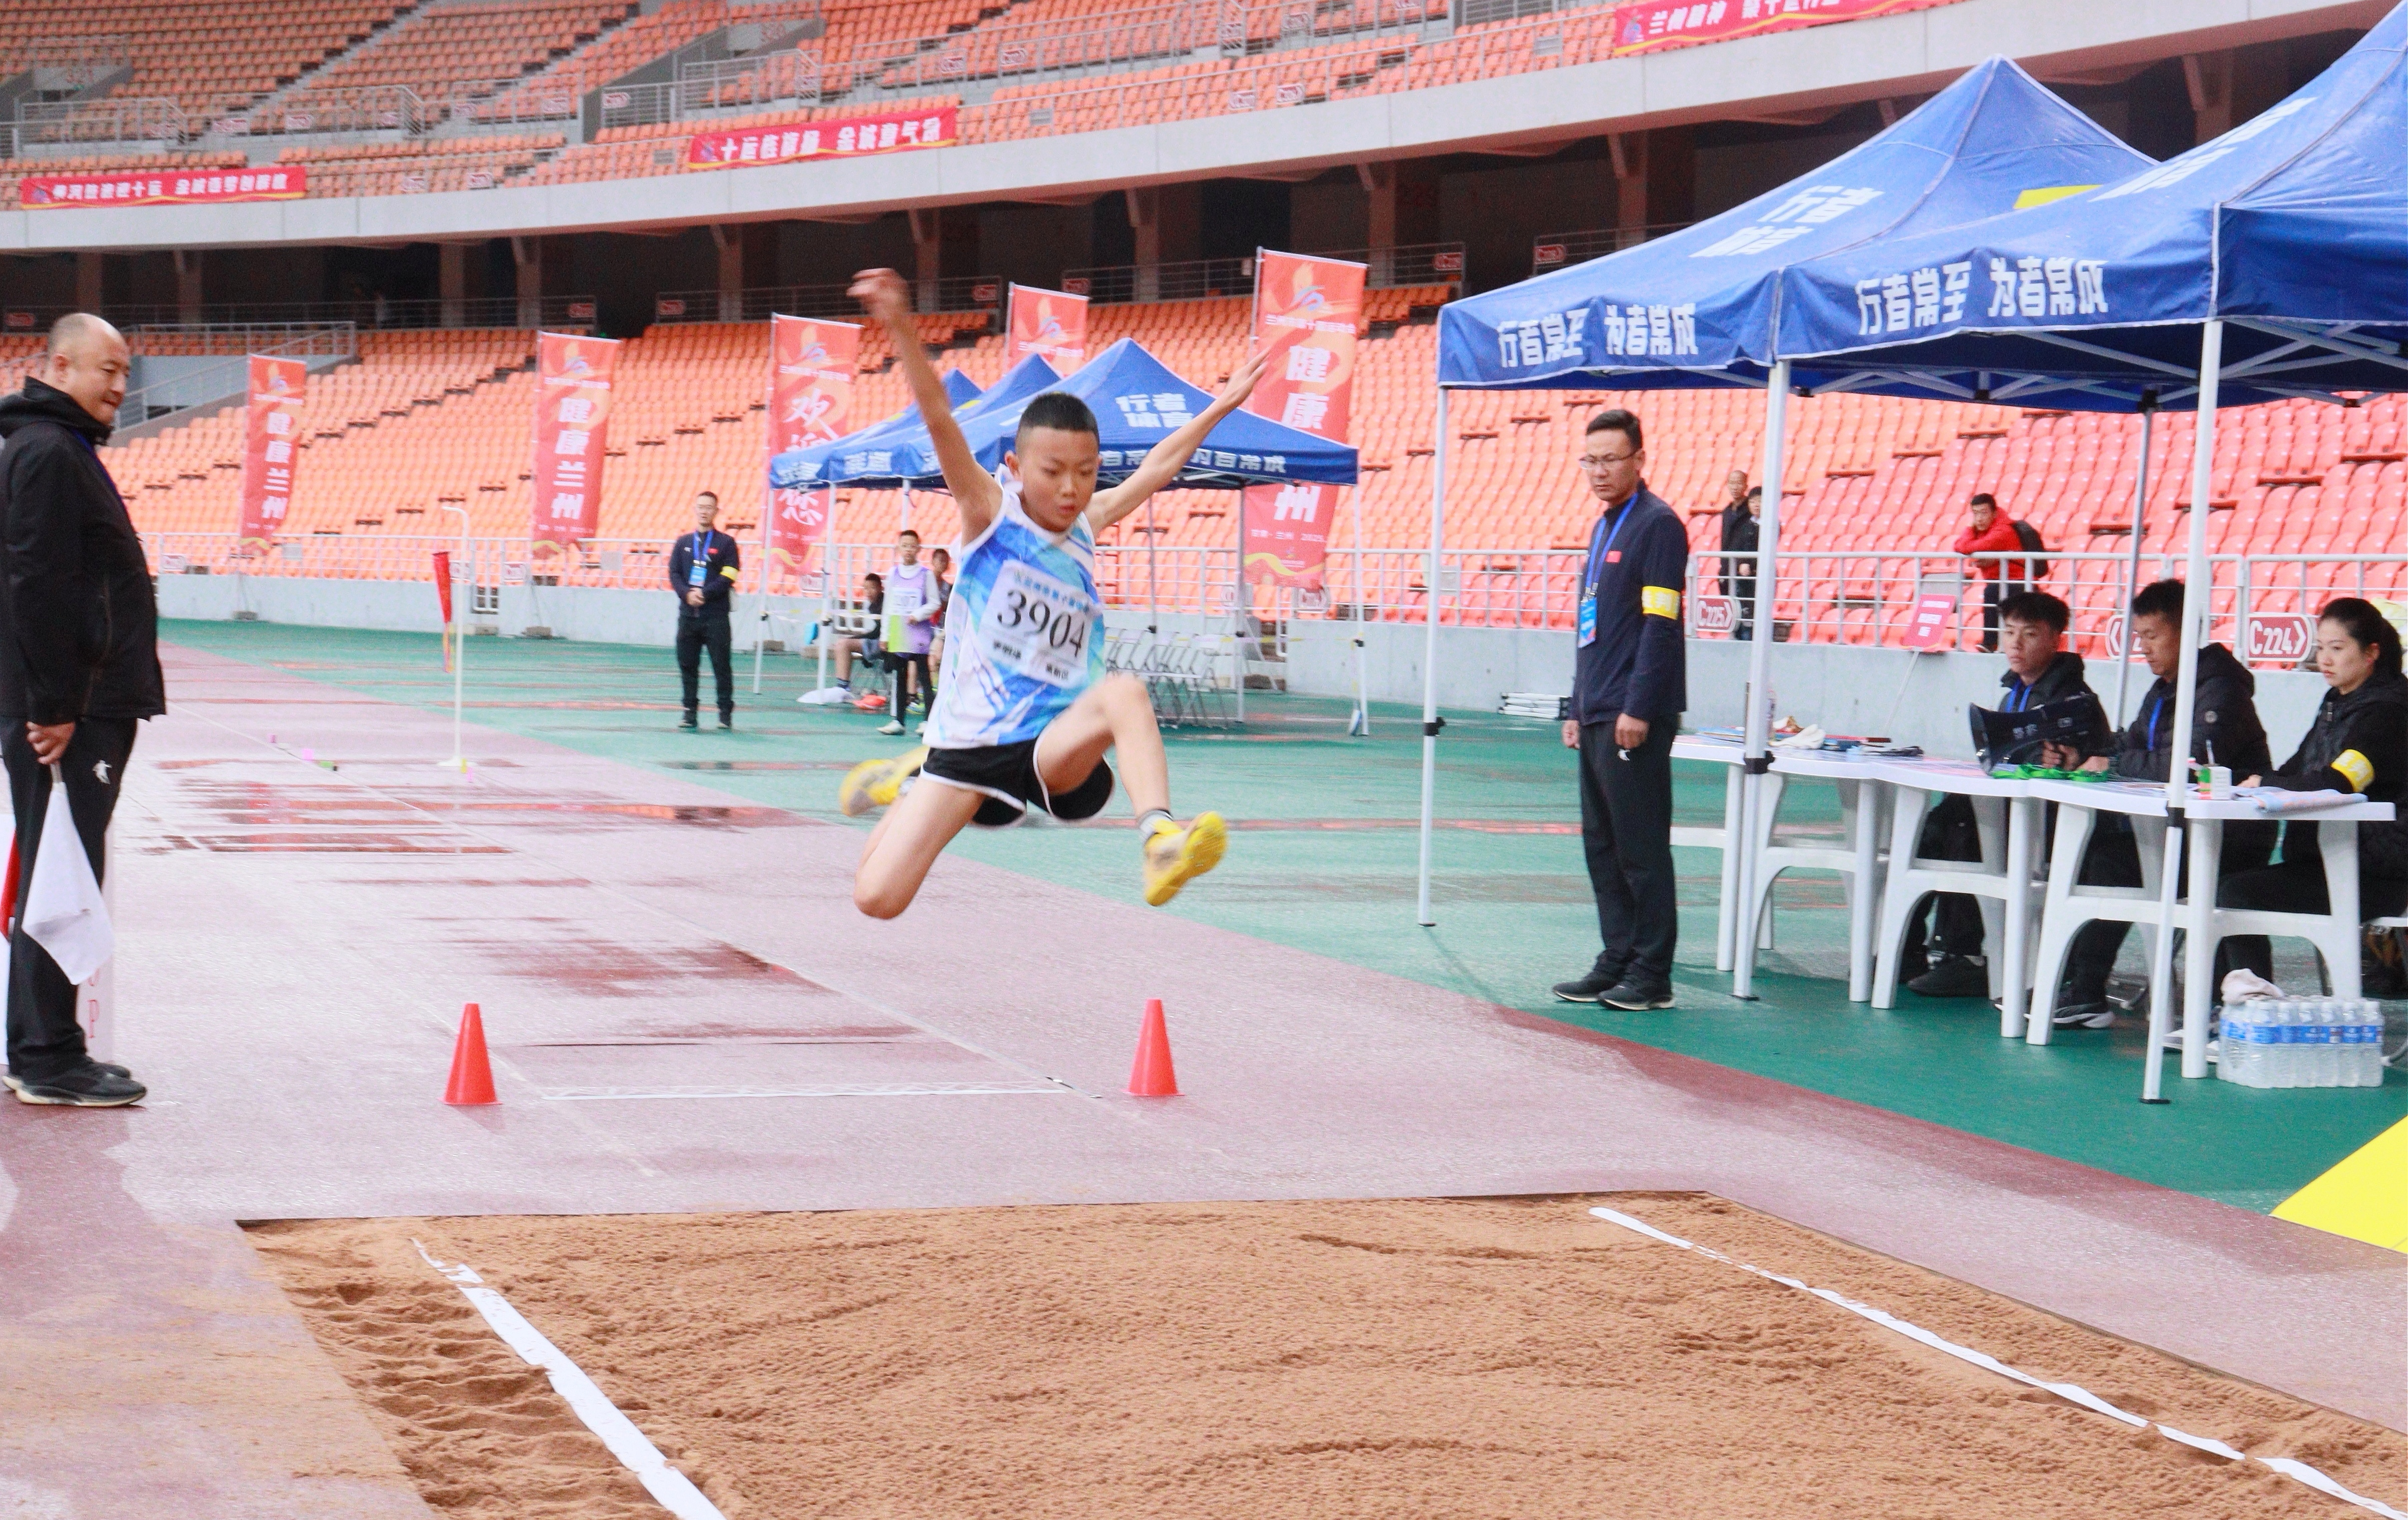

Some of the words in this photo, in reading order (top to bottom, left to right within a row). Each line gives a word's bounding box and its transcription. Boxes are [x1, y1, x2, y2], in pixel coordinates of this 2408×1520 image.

[1855, 261, 1972, 335] 行者常至
[1987, 256, 2109, 317] 为者常成
[1497, 308, 1590, 368] 行者常至
[1604, 303, 1699, 356] 为者常成
[551, 397, 590, 520] 健康兰州
[1273, 345, 1332, 523] 健康州
[998, 589, 1084, 658] 3904
[2250, 620, 2293, 654] C224
